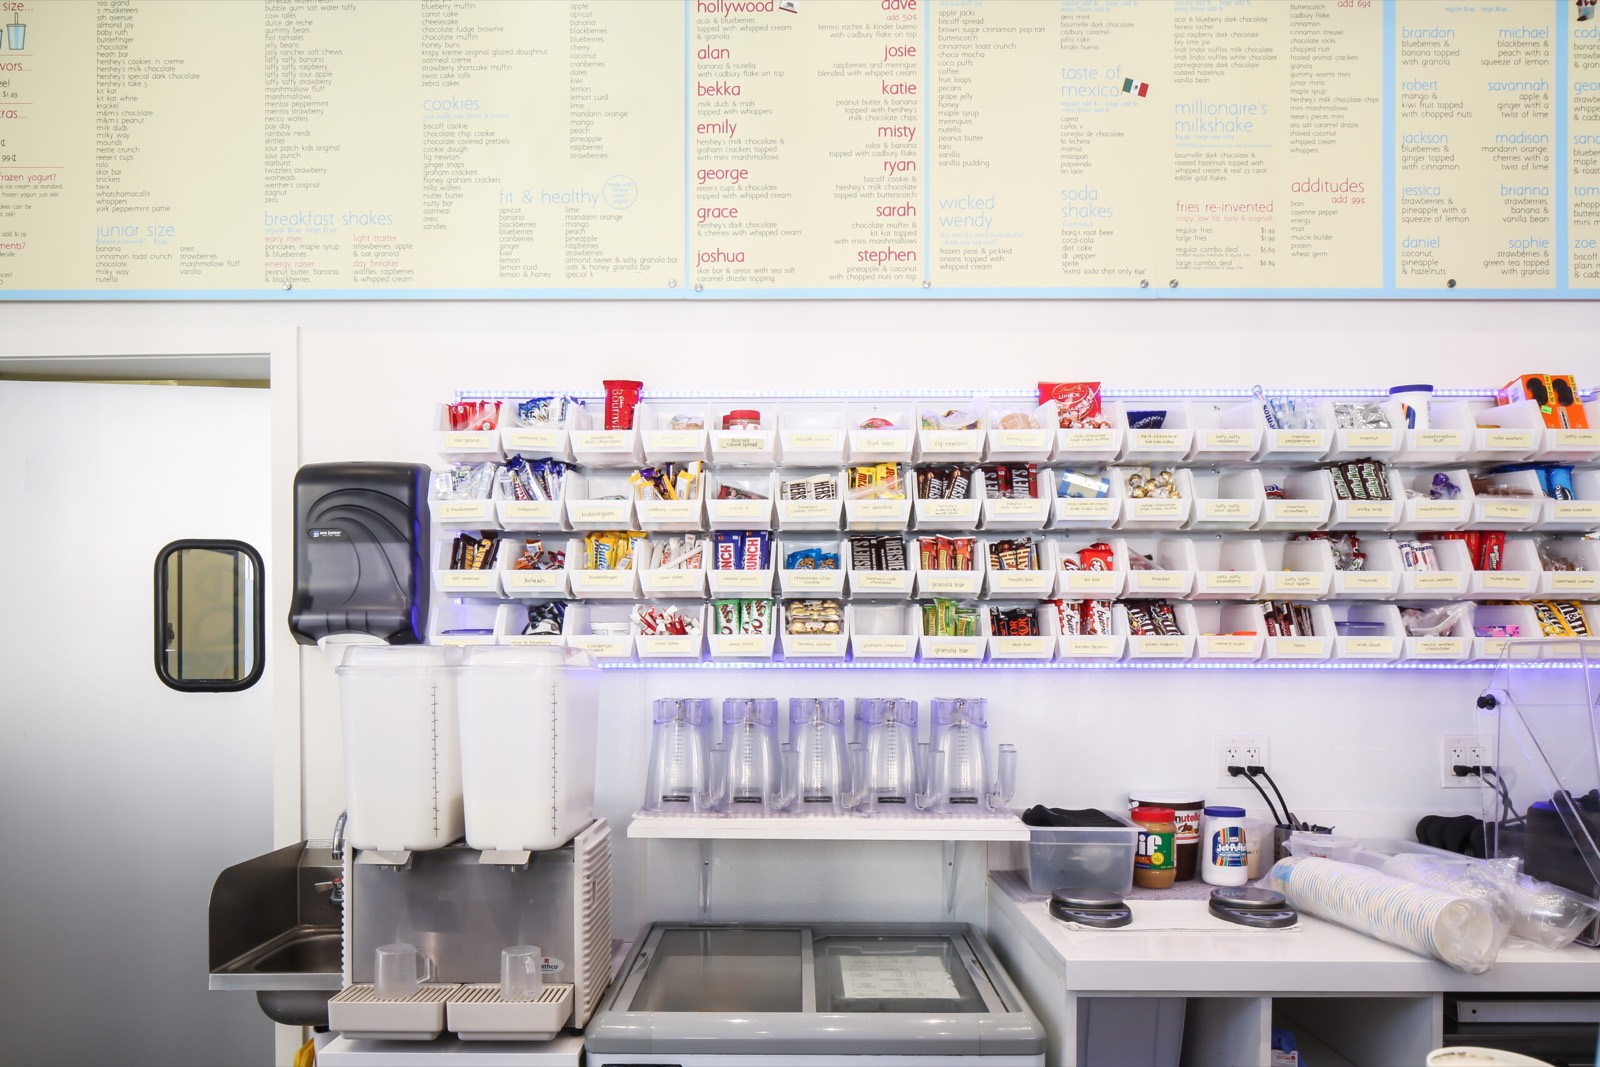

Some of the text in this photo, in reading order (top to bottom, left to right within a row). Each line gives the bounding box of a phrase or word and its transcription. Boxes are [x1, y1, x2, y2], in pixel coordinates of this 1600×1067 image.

[1402, 27, 1455, 38] brandon
[1500, 25, 1548, 38] michael
[97, 36, 133, 44] butterfinger
[698, 44, 730, 59] alan
[884, 44, 916, 61] josie
[1061, 64, 1122, 80] taste of
[698, 81, 740, 96] bekka
[882, 80, 916, 94] katie
[1061, 84, 1120, 98] mexico
[1402, 78, 1438, 91] robert
[1488, 79, 1549, 91] savannah
[423, 95, 480, 112] cookies
[1175, 100, 1267, 115] millionaire's
[741, 108, 772, 116] whoppers
[697, 119, 736, 138] emily
[1175, 117, 1253, 132] milkshake
[878, 125, 916, 142] misty
[1402, 131, 1448, 146] jackson
[1496, 131, 1549, 144] madison
[884, 161, 916, 176] ryan
[962, 160, 990, 168] pudding
[27, 174, 56, 183] yogurt?
[697, 169, 748, 184] george
[1291, 177, 1364, 193] additudes
[1402, 184, 1440, 199] jessica
[1501, 184, 1548, 196] brianna
[1574, 186, 1599, 196] tom
[500, 188, 514, 204] fit
[522, 190, 532, 204] &
[542, 188, 598, 208] healthy
[1062, 186, 1098, 201] soda
[1332, 195, 1347, 203] add
[96, 198, 127, 206] whoppers
[876, 202, 916, 216] sarah
[939, 194, 994, 210] wicked
[1177, 200, 1273, 212] fries re-invented
[265, 210, 392, 226] breakfast shakes
[697, 208, 738, 222] grace
[1063, 203, 1113, 218] shakes
[940, 214, 992, 230] wendy
[96, 224, 174, 239] junior size
[1176, 227, 1197, 235] regular
[265, 234, 283, 244] early
[1402, 236, 1440, 248] daniel
[1509, 237, 1549, 253] sophie
[1575, 240, 1596, 248] zoe
[696, 248, 744, 267] joshua
[858, 246, 916, 265] stephen
[1263, 405, 1277, 429] entos
[1012, 469, 1029, 494] HEY'S
[746, 539, 758, 570] RUNCH
[854, 541, 871, 570] RSHEY'S
[886, 540, 904, 570] HERSHE
[1096, 610, 1106, 634] bueno
[1138, 834, 1162, 856] if
